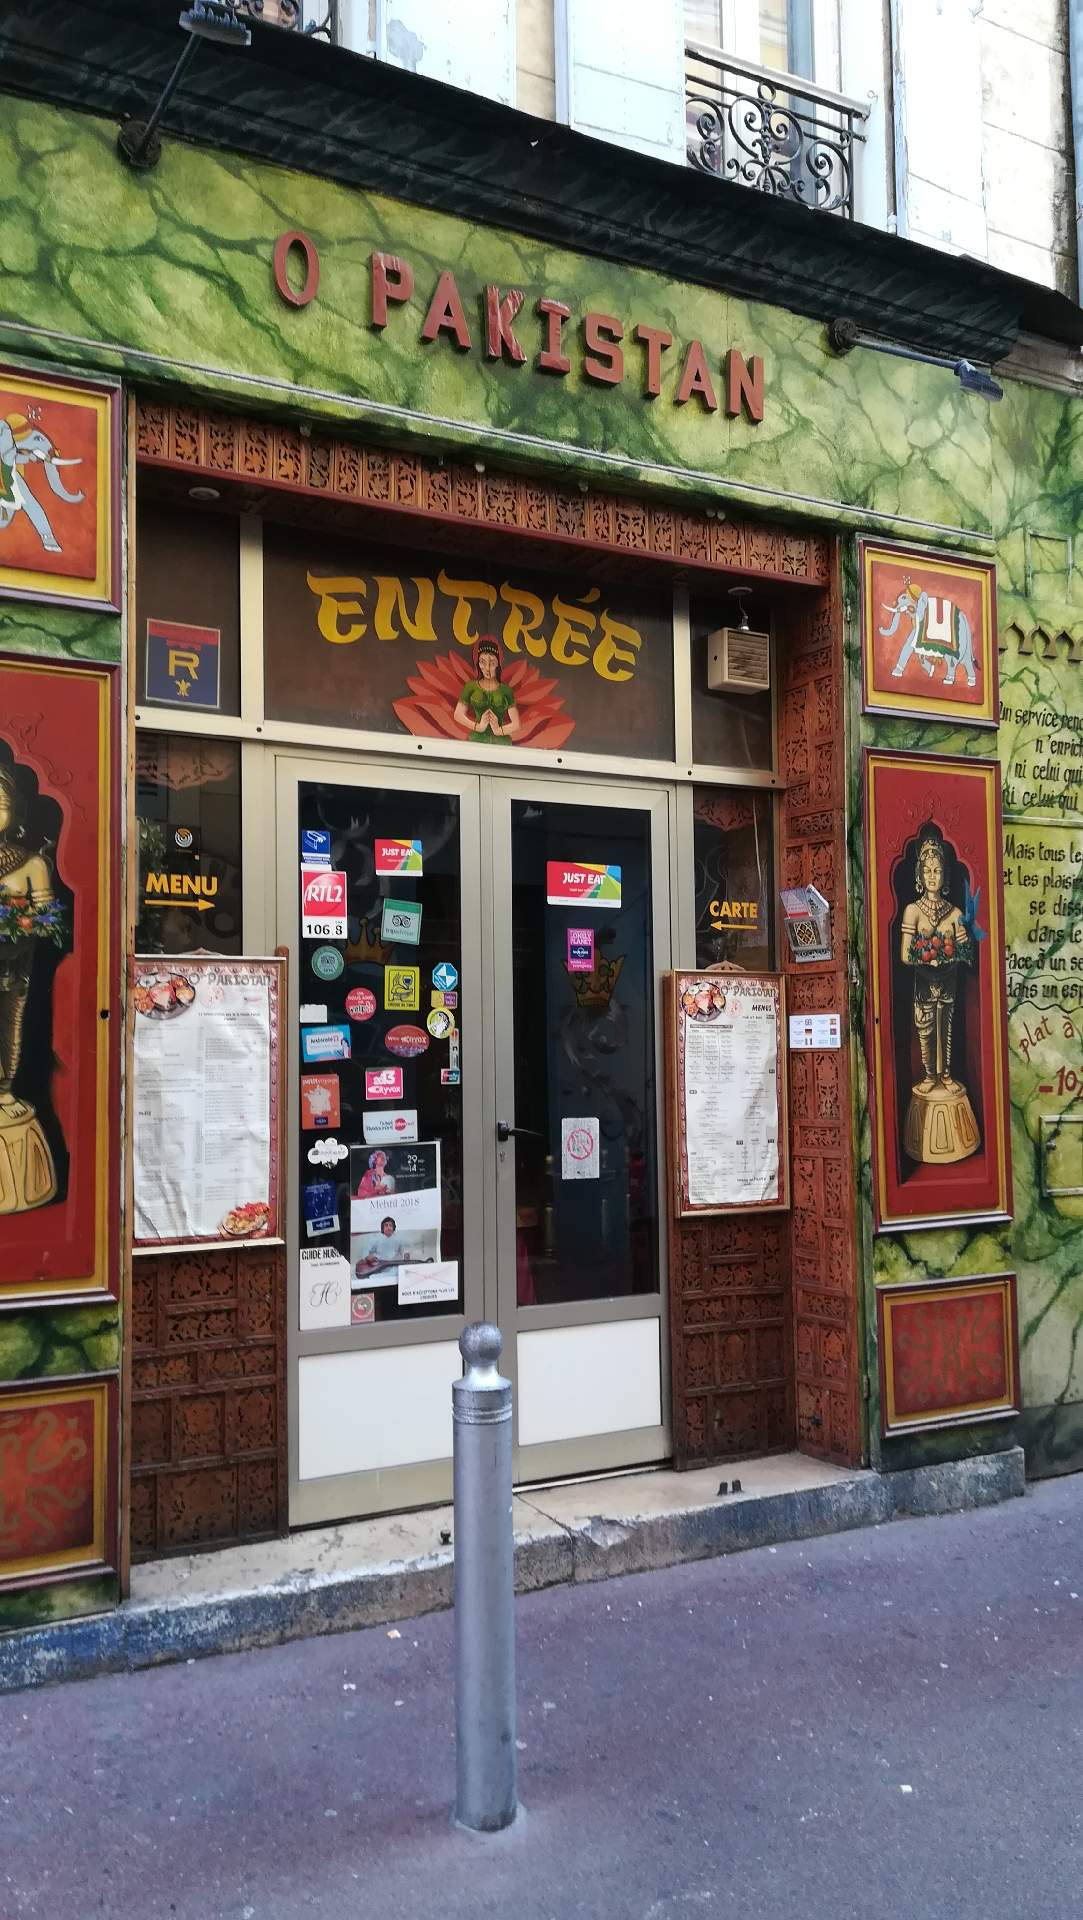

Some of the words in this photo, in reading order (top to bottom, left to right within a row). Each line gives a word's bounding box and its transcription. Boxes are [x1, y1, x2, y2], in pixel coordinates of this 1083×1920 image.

[274, 230, 320, 306] O
[369, 251, 765, 423] PAKISTAN
[306, 568, 643, 682] ENTRÉE
[1015, 708, 1058, 728] service
[1015, 759, 1026, 779] ni
[1033, 758, 1060, 782] celui
[1064, 765, 1083, 787] qui
[1023, 784, 1054, 809] celui
[1059, 792, 1078, 817] qui
[381, 847, 400, 857] JUST
[400, 848, 414, 857] EAT
[1004, 833, 1035, 860] Mais
[1039, 841, 1066, 862] tous
[145, 872, 218, 896] MENU
[562, 872, 586, 885] JUST
[587, 874, 606, 885] EAT
[306, 883, 343, 903] RTL2
[709, 900, 758, 919] CARTE
[1030, 900, 1046, 916] se
[1028, 918, 1065, 943] dans
[1050, 957, 1066, 971] un
[1042, 984, 1058, 999] un
[1019, 1015, 1052, 1064] plat
[1062, 1015, 1075, 1039] à
[400, 1198, 420, 1208] 2018
[302, 1249, 321, 1261] GUIDE
